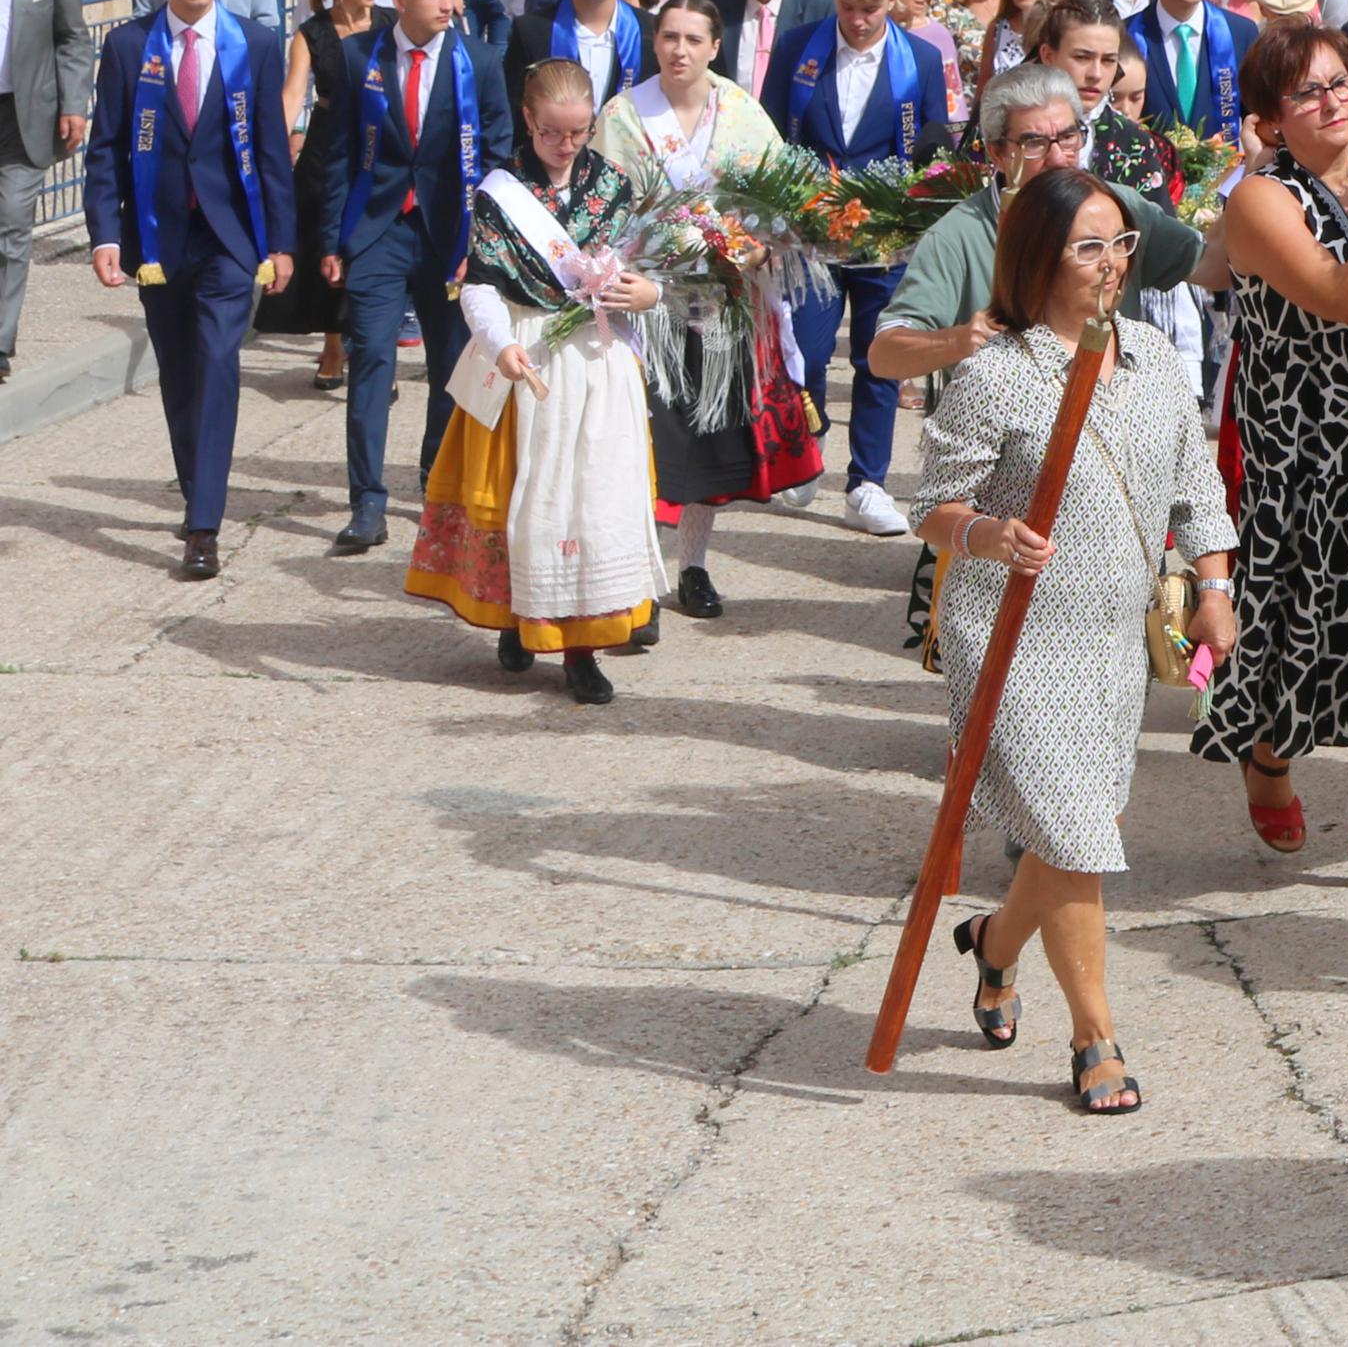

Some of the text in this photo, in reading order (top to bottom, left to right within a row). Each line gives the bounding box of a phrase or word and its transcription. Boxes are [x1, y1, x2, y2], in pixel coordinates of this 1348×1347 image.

[137, 107, 156, 152] MISTER
[461, 124, 475, 178] FIESTAS
[902, 101, 916, 155] FIESTAS
